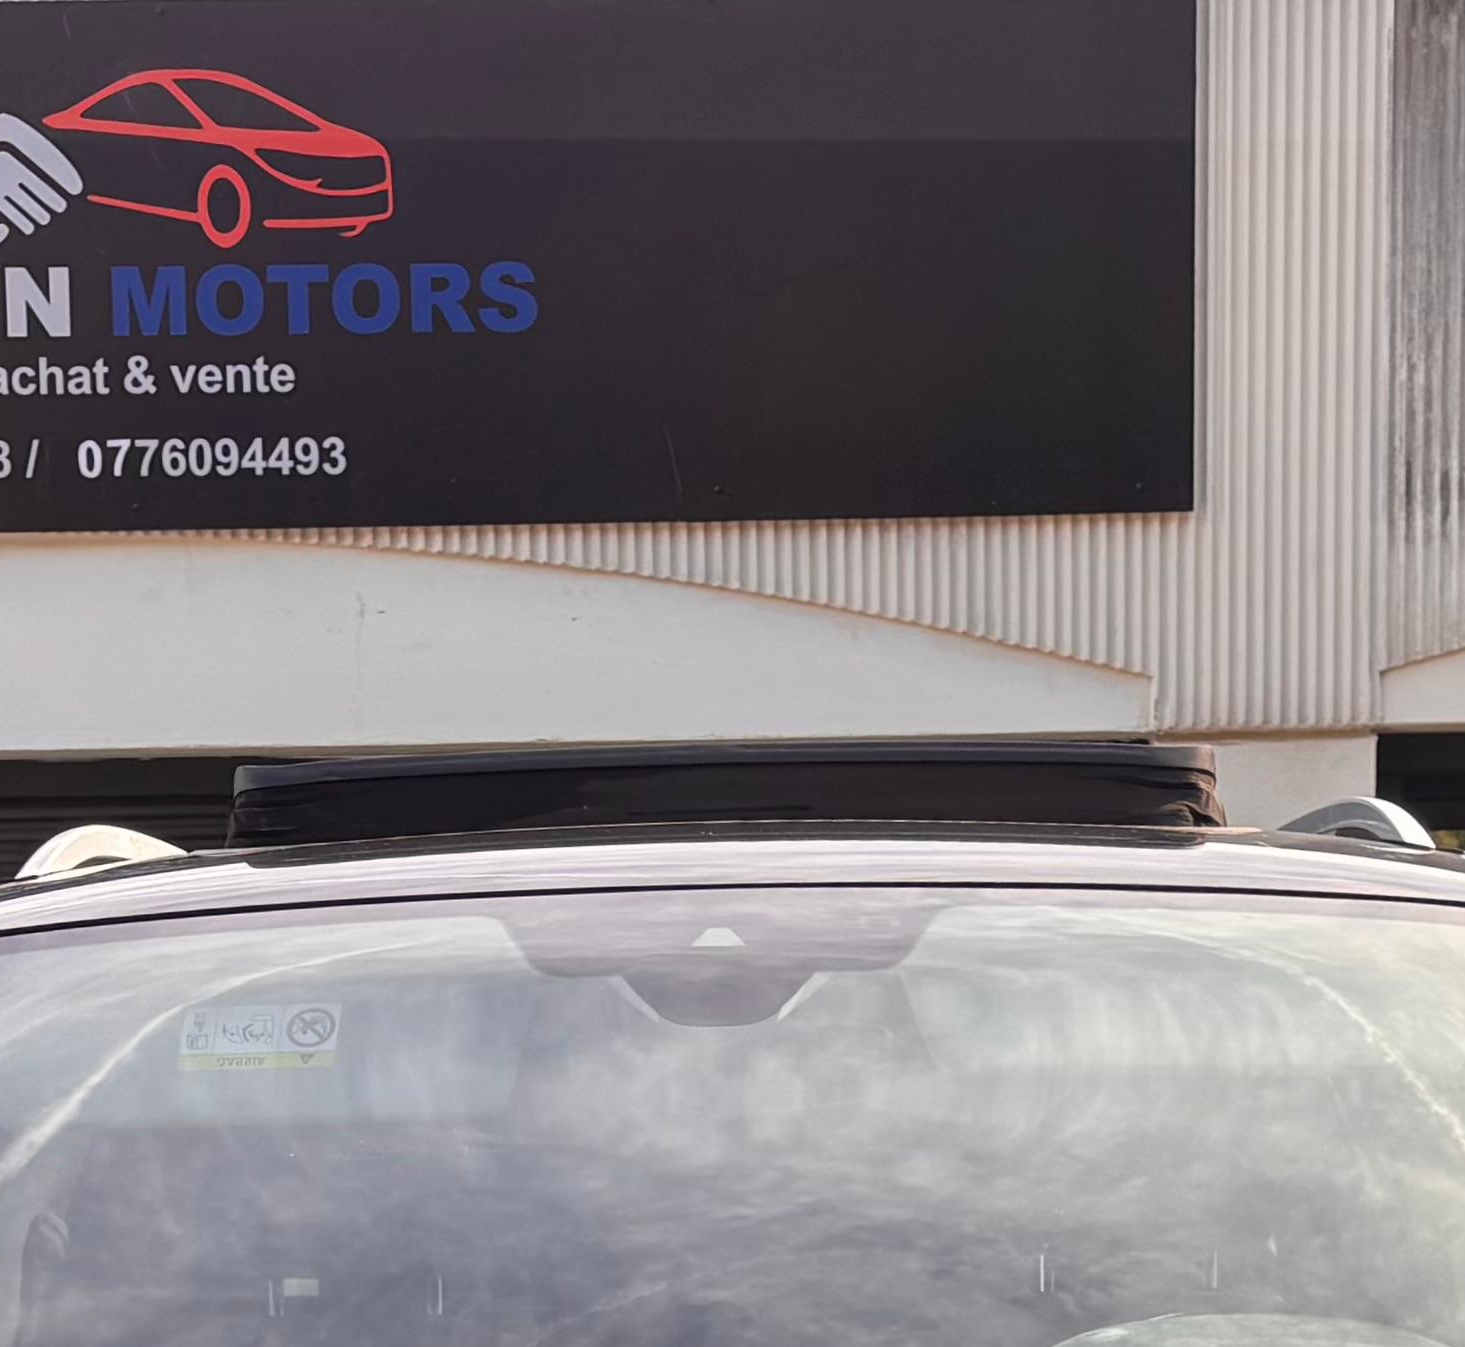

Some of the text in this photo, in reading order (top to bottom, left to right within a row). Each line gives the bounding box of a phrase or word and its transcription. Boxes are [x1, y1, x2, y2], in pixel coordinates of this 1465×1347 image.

[112, 261, 538, 337] MOTORS
[124, 355, 157, 395] &
[169, 355, 296, 394] vente
[25, 439, 40, 479] /
[77, 436, 347, 479] 0776094493
